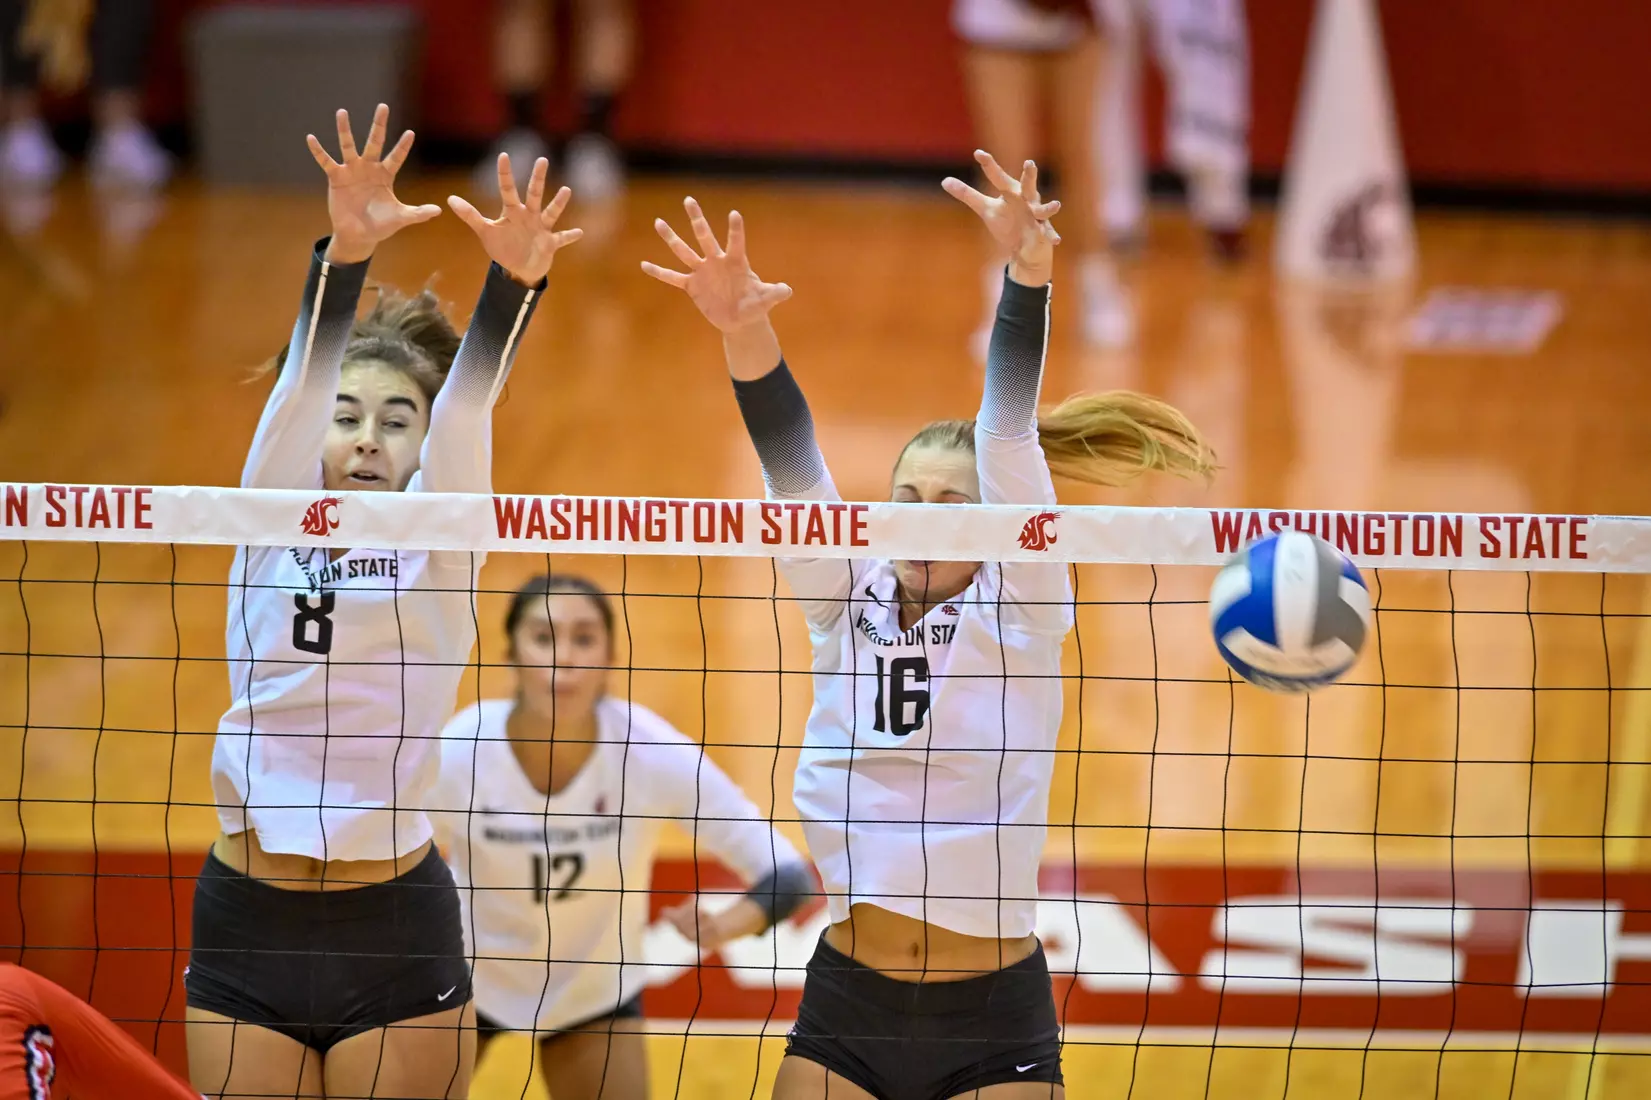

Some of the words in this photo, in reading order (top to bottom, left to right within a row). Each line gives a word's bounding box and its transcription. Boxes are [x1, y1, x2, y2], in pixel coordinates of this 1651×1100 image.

[44, 485, 153, 529] STATE
[492, 496, 744, 544] WASHINGTON
[759, 501, 870, 547] STATE
[1478, 516, 1589, 560] STATE
[348, 558, 398, 579] STATE
[292, 591, 336, 655] 8
[872, 652, 931, 737] 16
[531, 852, 585, 904] 12
